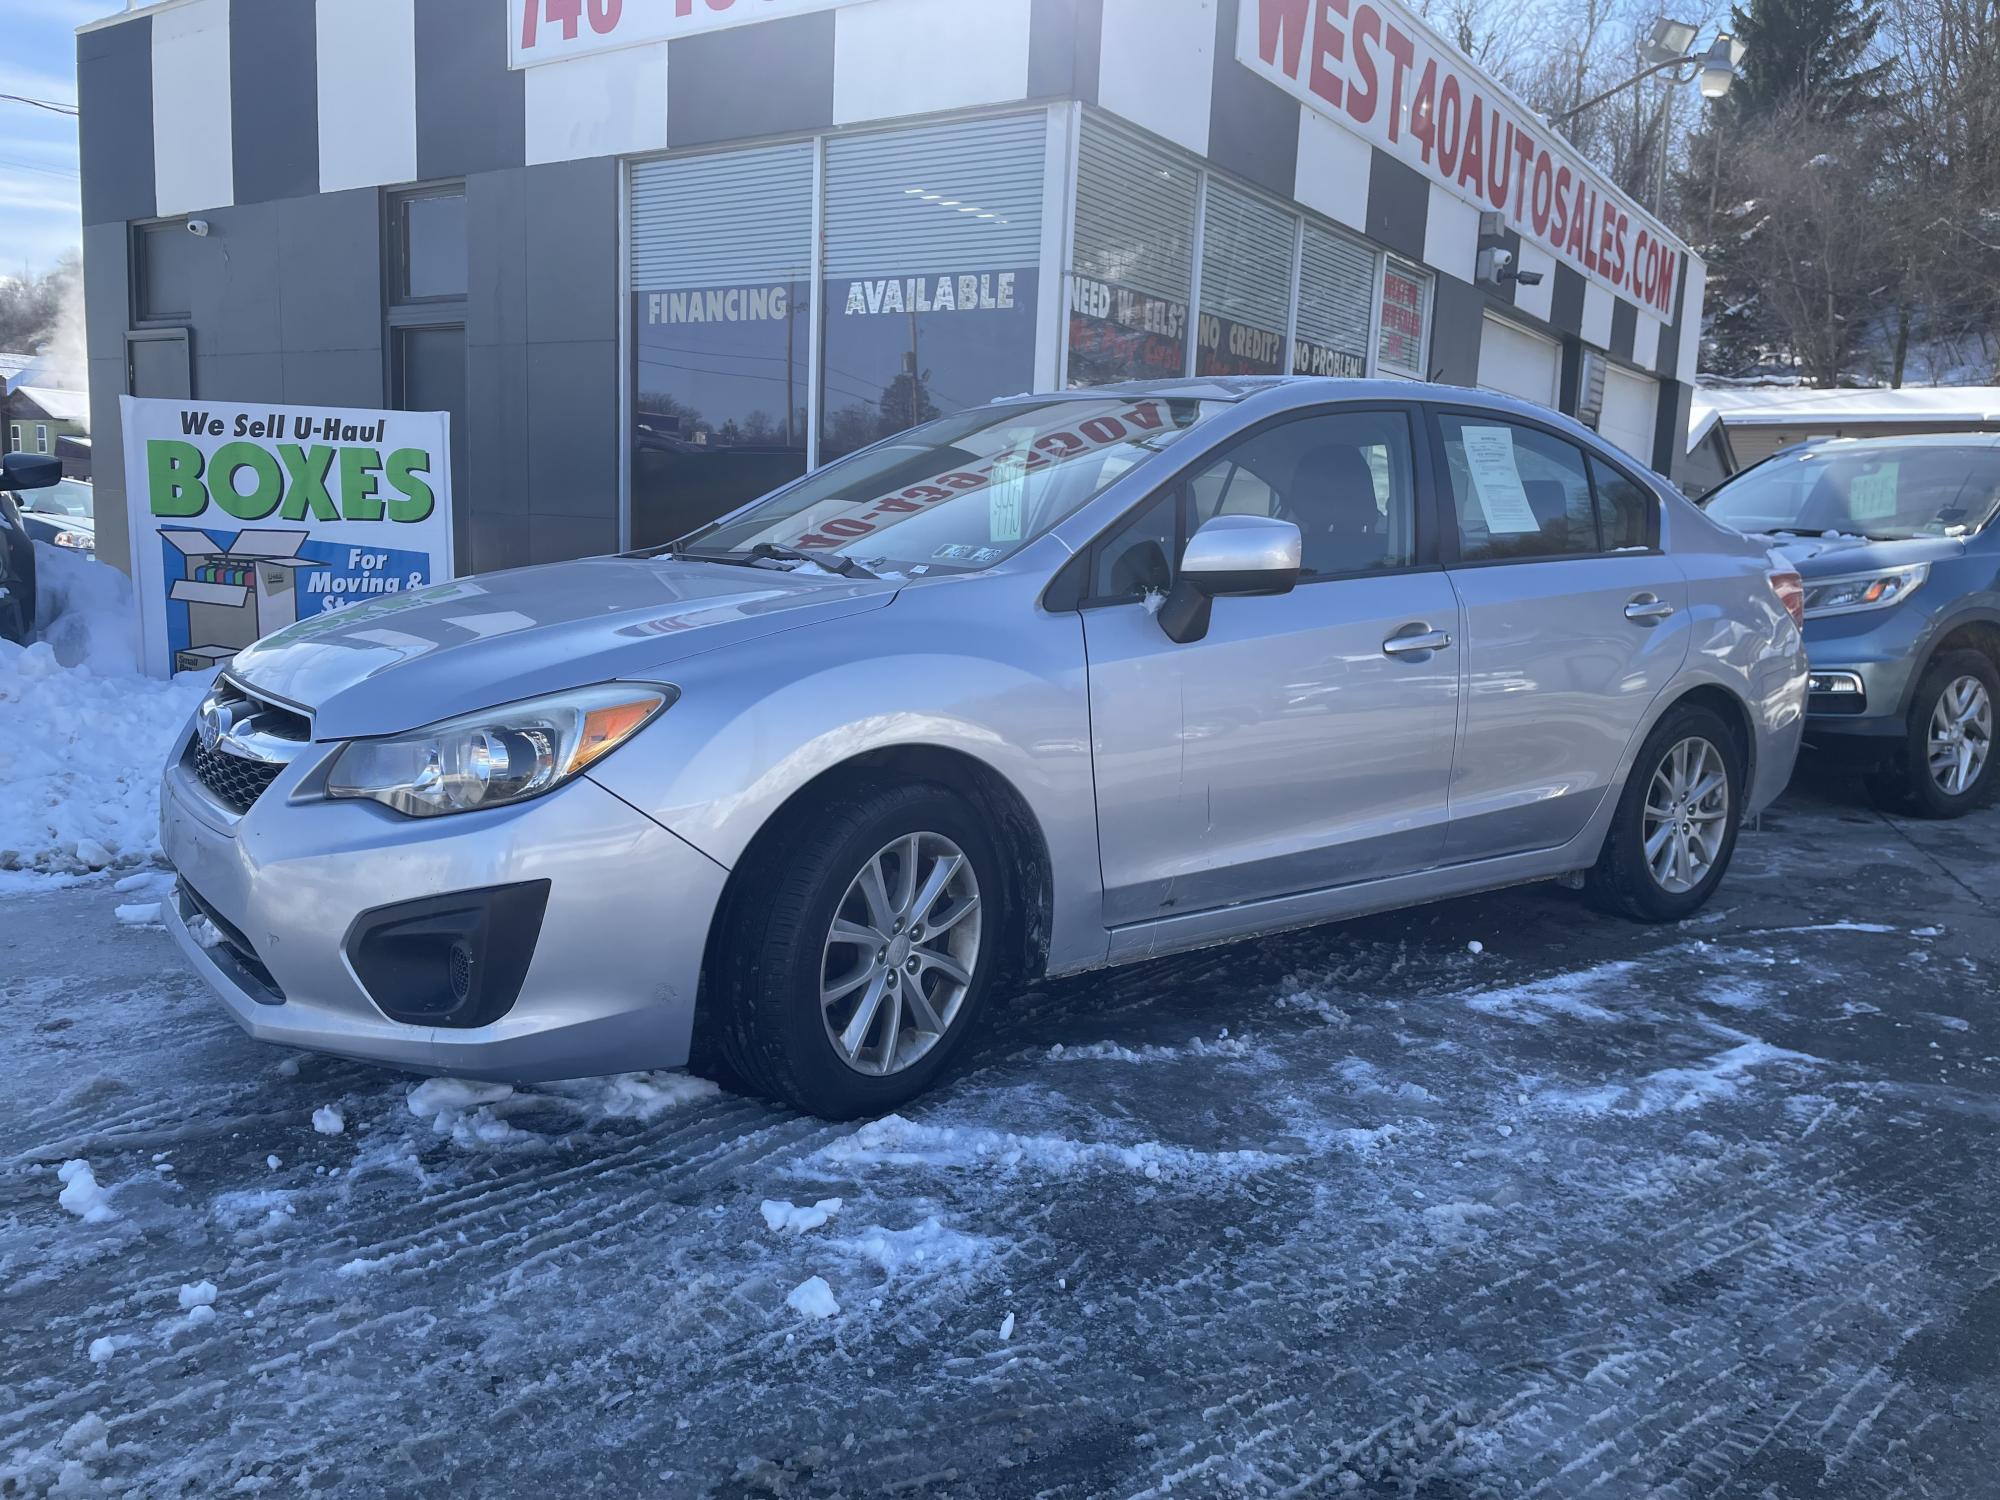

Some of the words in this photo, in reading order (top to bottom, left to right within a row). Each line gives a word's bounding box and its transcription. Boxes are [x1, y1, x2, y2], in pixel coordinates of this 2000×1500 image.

[1259, 0, 1676, 314] WEST40AUTOSALES.COM
[648, 287, 787, 324] FINANCING
[845, 273, 1016, 315] AVAILABLE
[1071, 276, 1111, 319] NEED
[1199, 314, 1221, 350] NO
[1229, 323, 1280, 365] CREDIT?
[1294, 342, 1310, 372] NO
[1312, 347, 1363, 378] PROBLEM!
[181, 411, 225, 436] We
[233, 413, 285, 439] Sell
[293, 416, 386, 443] U-Haul
[147, 439, 436, 524] BOXES
[348, 548, 388, 571] For
[307, 570, 400, 594] Moving
[406, 571, 425, 593] &
[179, 655, 199, 667] Small
